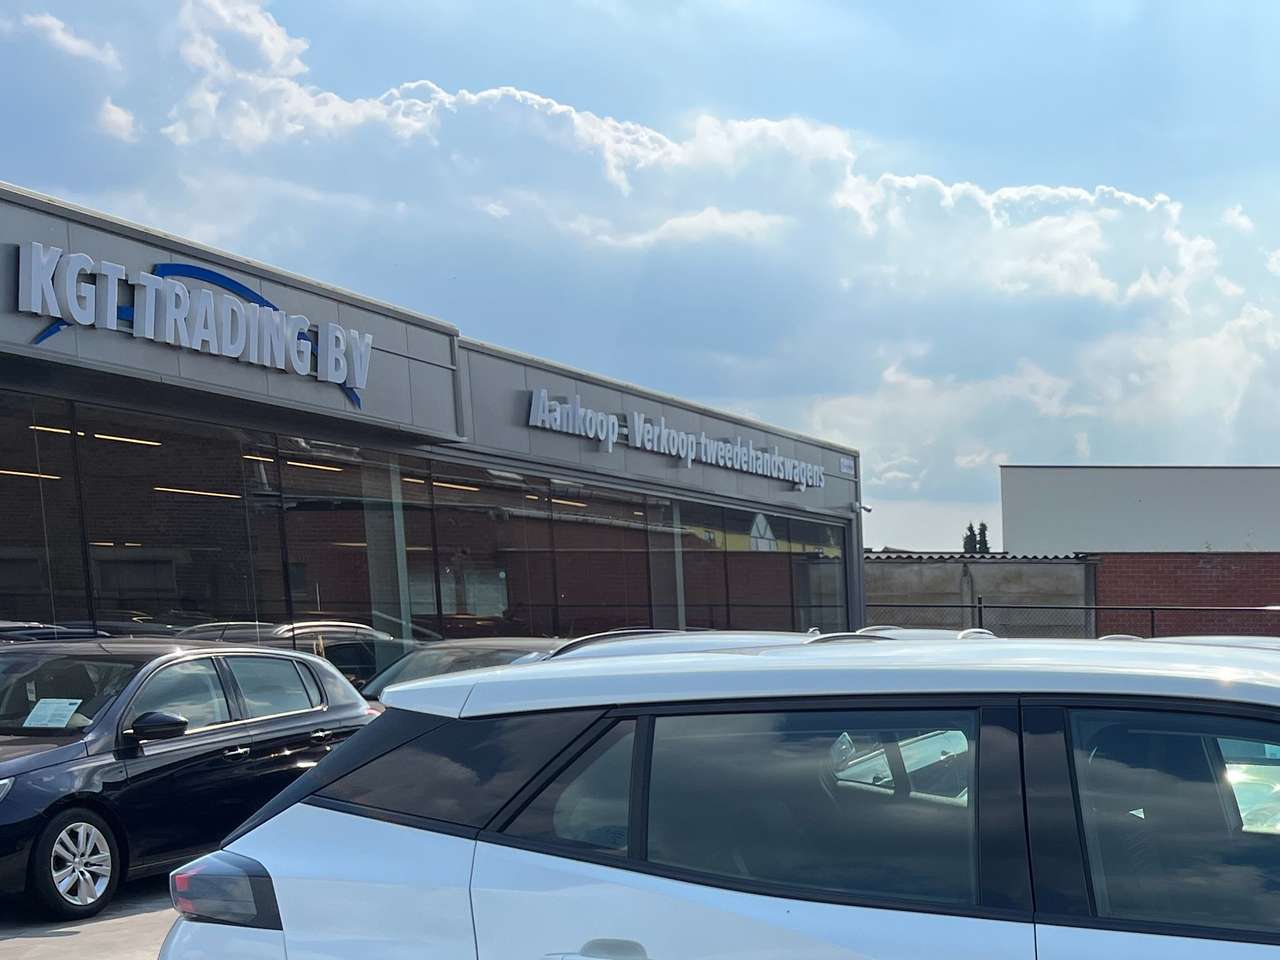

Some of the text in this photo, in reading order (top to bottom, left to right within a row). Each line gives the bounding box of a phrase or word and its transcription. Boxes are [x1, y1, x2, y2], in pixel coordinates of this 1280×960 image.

[18, 241, 374, 389] KGT TRADING BV
[529, 388, 618, 453] Aankoop
[629, 411, 696, 468] Verkoop
[701, 432, 824, 492] tweedehandswagens
